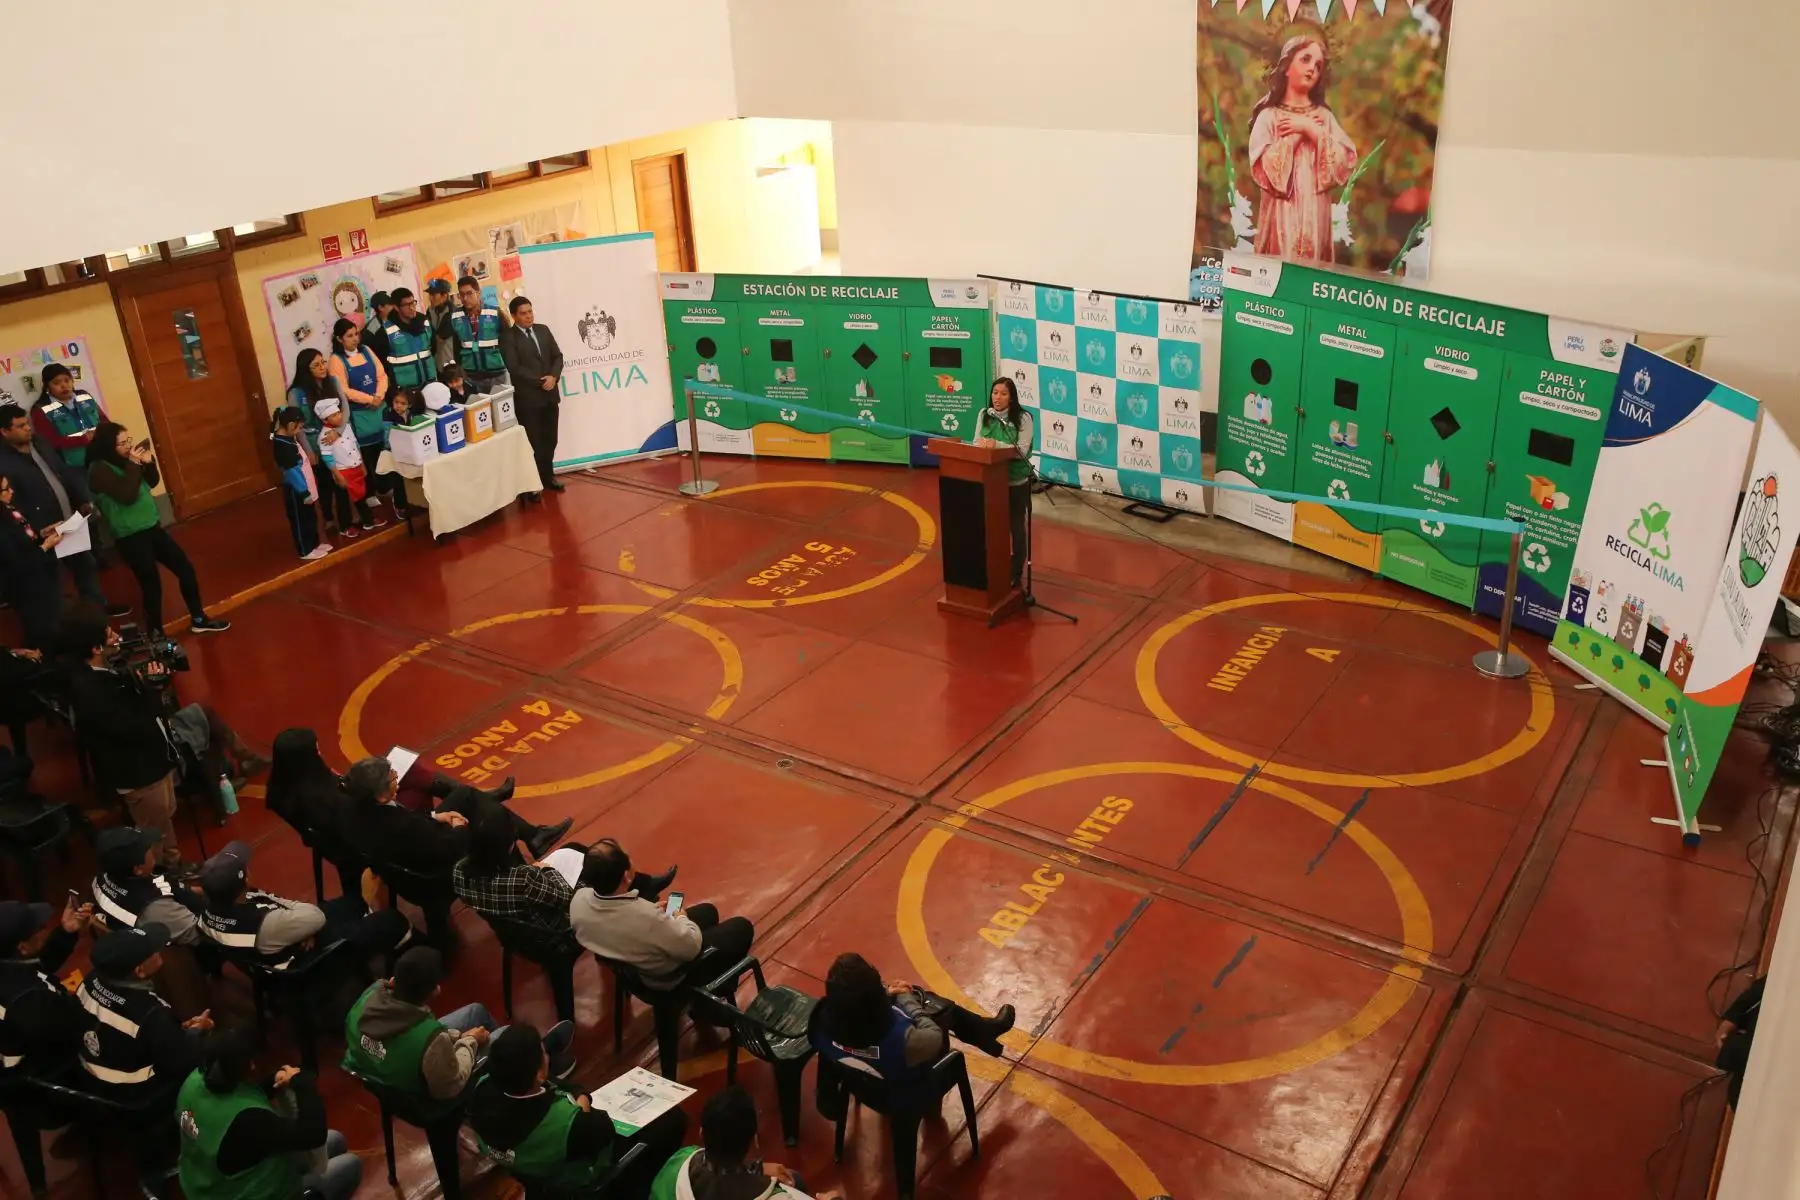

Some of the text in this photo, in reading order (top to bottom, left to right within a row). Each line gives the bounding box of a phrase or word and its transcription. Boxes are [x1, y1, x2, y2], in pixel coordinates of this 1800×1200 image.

[743, 282, 898, 299] ESTACIÓN DE RECICLAJE
[688, 306, 717, 315] PLÁSTICO
[1005, 300, 1029, 312] LIMA
[1245, 301, 1286, 318] PLÁSTICO
[1312, 282, 1506, 337] ESTACIÓN DE RECICLAJE
[1081, 311, 1109, 323] LIMA
[931, 322, 960, 330] CARTÓN
[1165, 323, 1197, 336] LIMA
[1338, 324, 1368, 339] METAL
[632, 349, 644, 359] DE
[1044, 352, 1069, 364] LIMA
[1434, 346, 1470, 362] VIDRIO
[1122, 364, 1152, 378] LIMA
[1540, 370, 1586, 388] PAPEL Y
[561, 364, 648, 396] LIMA
[1537, 383, 1585, 403] CARTÓN
[1083, 405, 1109, 417] LIMA
[1562, 402, 1597, 418] compactado
[1619, 398, 1652, 427] LIMA
[1166, 418, 1197, 430] LIMA
[1047, 440, 1070, 452] LIMA
[1123, 456, 1153, 469] LIMA
[746, 541, 830, 588] 5 AÑOS
[1484, 584, 1493, 592] NO
[1206, 624, 1288, 692] INFANCIA
[1304, 647, 1341, 664] A
[435, 699, 551, 770] 4 AÑOS
[460, 708, 583, 784] AULA DE
[978, 795, 1134, 950] ABLACNTES
